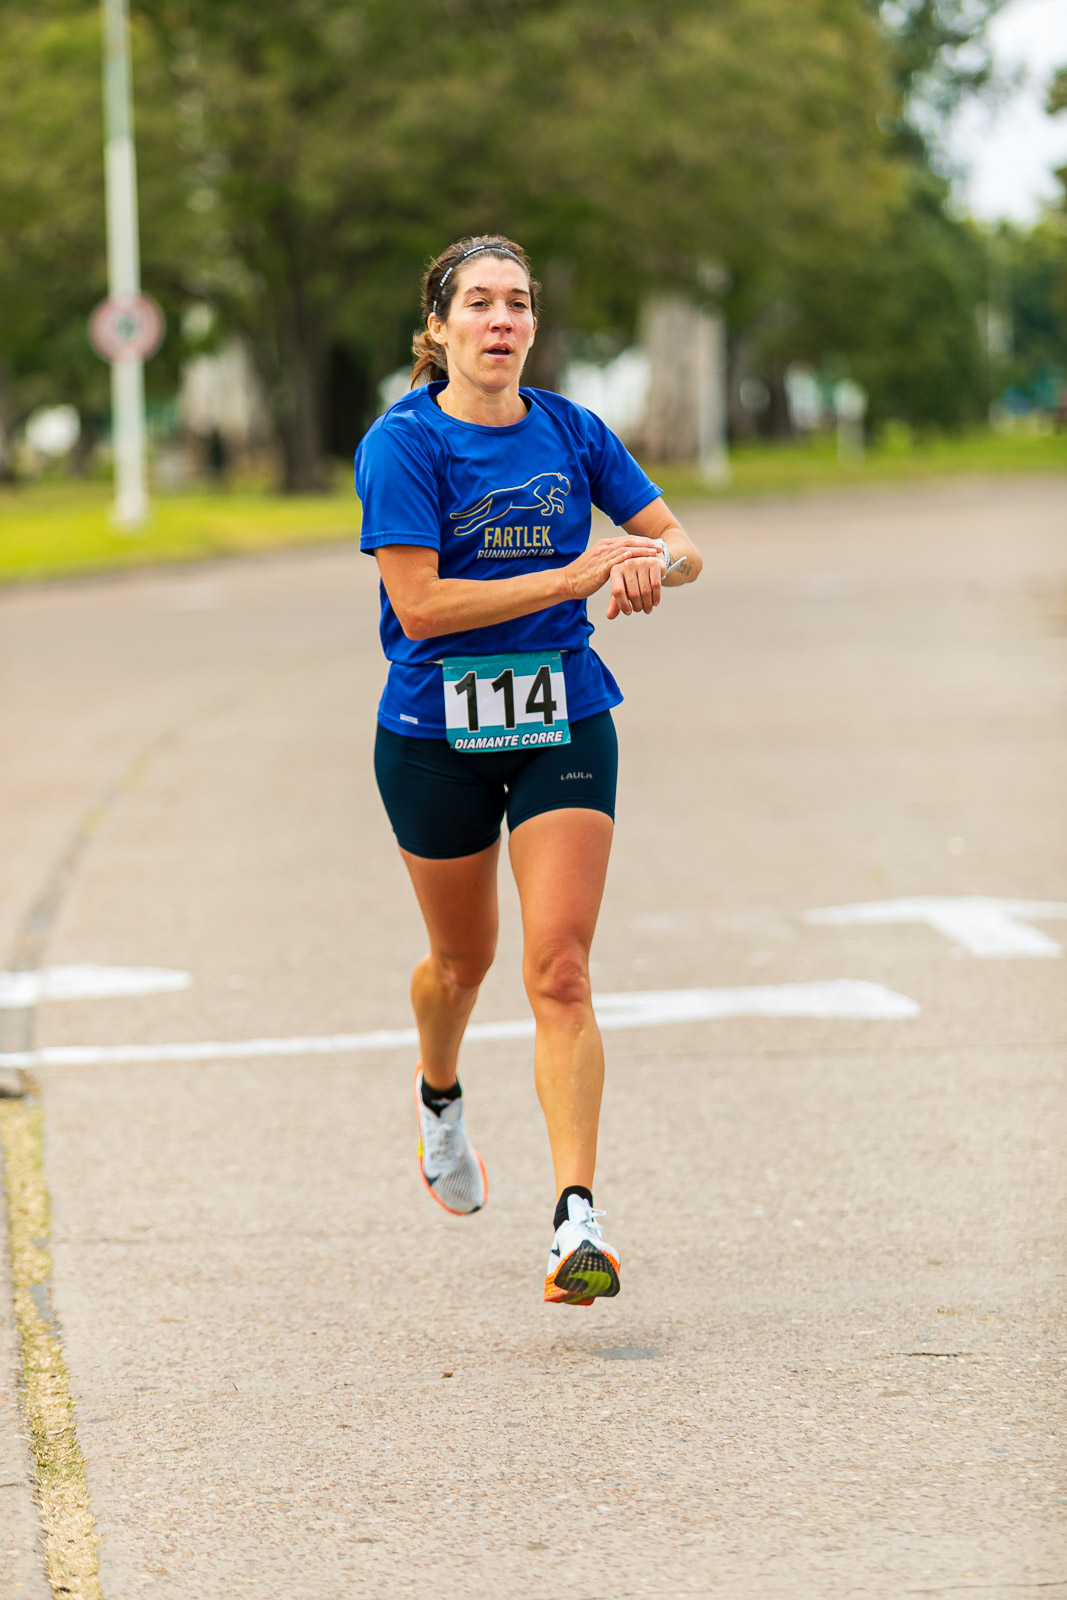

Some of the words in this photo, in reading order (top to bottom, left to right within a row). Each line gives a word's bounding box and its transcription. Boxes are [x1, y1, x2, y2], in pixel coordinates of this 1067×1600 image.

[484, 526, 552, 548] FARTLEK
[454, 665, 557, 733] 114
[454, 735, 519, 749] DIAMANTE
[521, 731, 563, 745] CORRE
